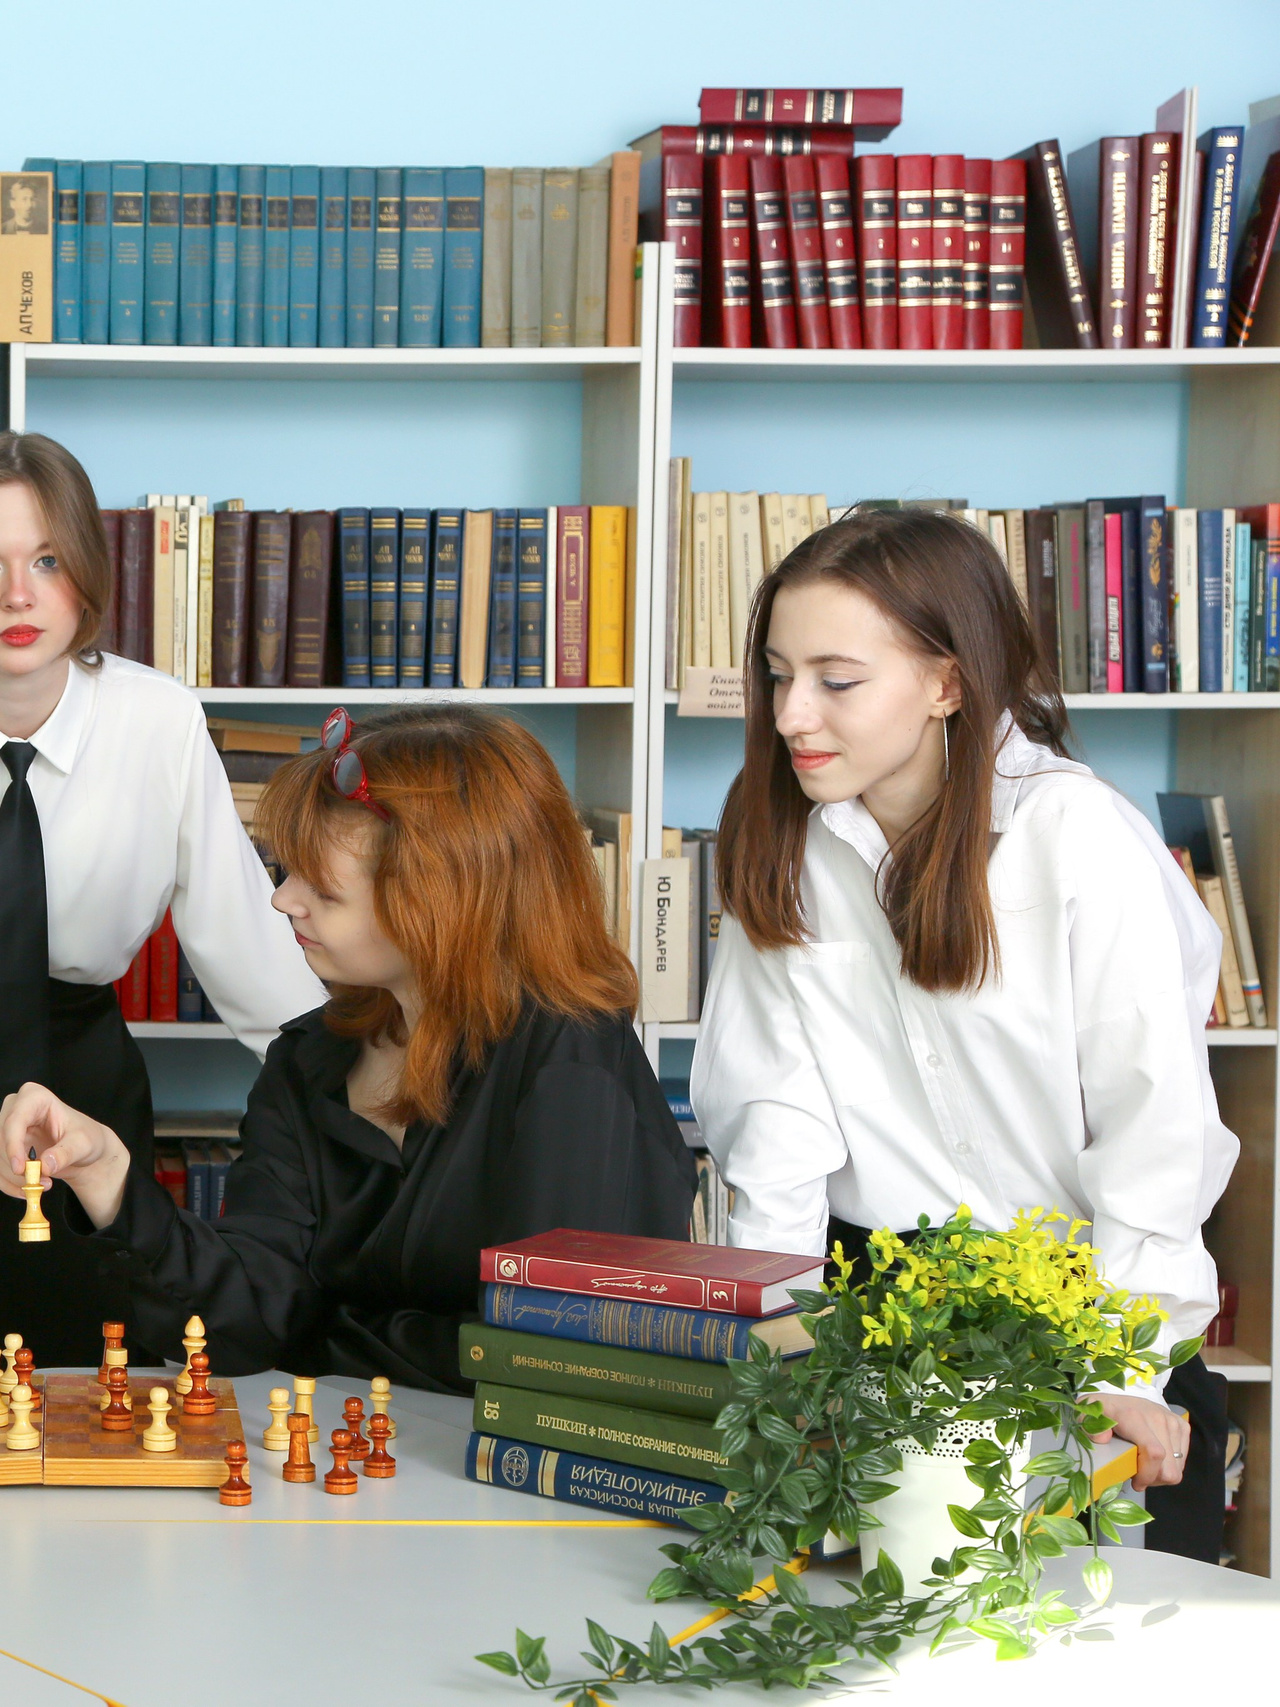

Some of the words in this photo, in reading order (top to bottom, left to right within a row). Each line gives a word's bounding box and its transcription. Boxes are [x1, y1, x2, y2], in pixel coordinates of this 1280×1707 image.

[1112, 171, 1127, 234] ПАМЯТИ
[1111, 240, 1126, 290] КНИГА
[710, 675, 744, 684] Книг
[713, 1290, 728, 1300] 3
[512, 1354, 563, 1374] СОЧИНЕНИЙ
[565, 1362, 609, 1381] СОБРАНИЕ
[610, 1370, 646, 1386] ПОЛНОЕ
[658, 1380, 714, 1398] ПУШКИН
[484, 1400, 499, 1420] 18
[536, 1414, 587, 1436] ПУШКИН
[598, 1426, 631, 1445] ПОЛНОЕ
[632, 1434, 676, 1455] СОБРАНИЕ
[571, 1465, 706, 1507] ЭНЦИКЛОПЕДИЯ
[570, 1484, 645, 1512] РОССИЙСКАЯ
